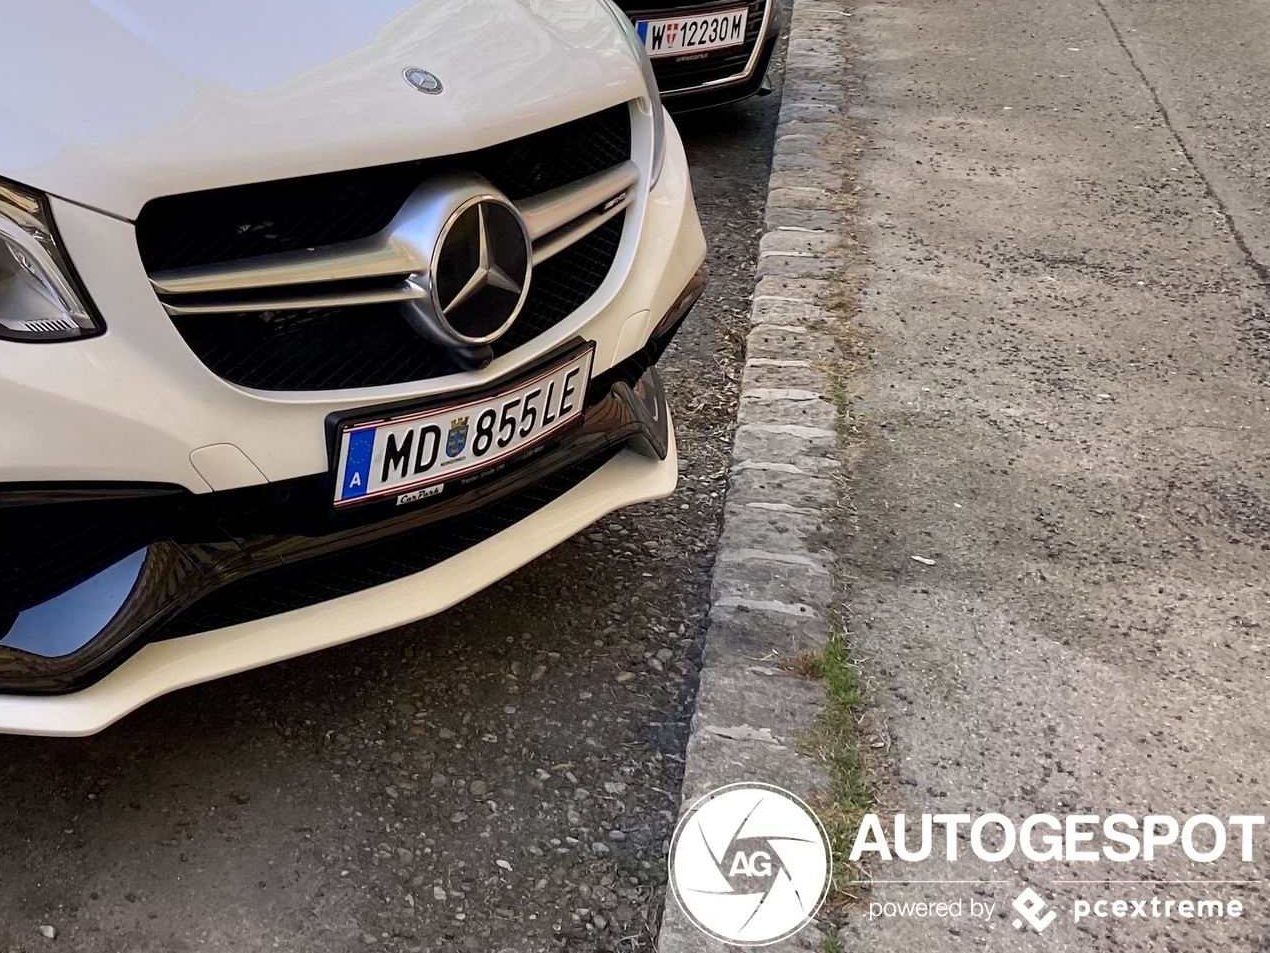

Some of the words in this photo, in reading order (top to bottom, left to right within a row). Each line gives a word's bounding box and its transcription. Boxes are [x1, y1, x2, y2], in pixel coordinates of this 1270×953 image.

[652, 24, 666, 50] W
[381, 425, 441, 482] MD
[349, 472, 361, 488] A
